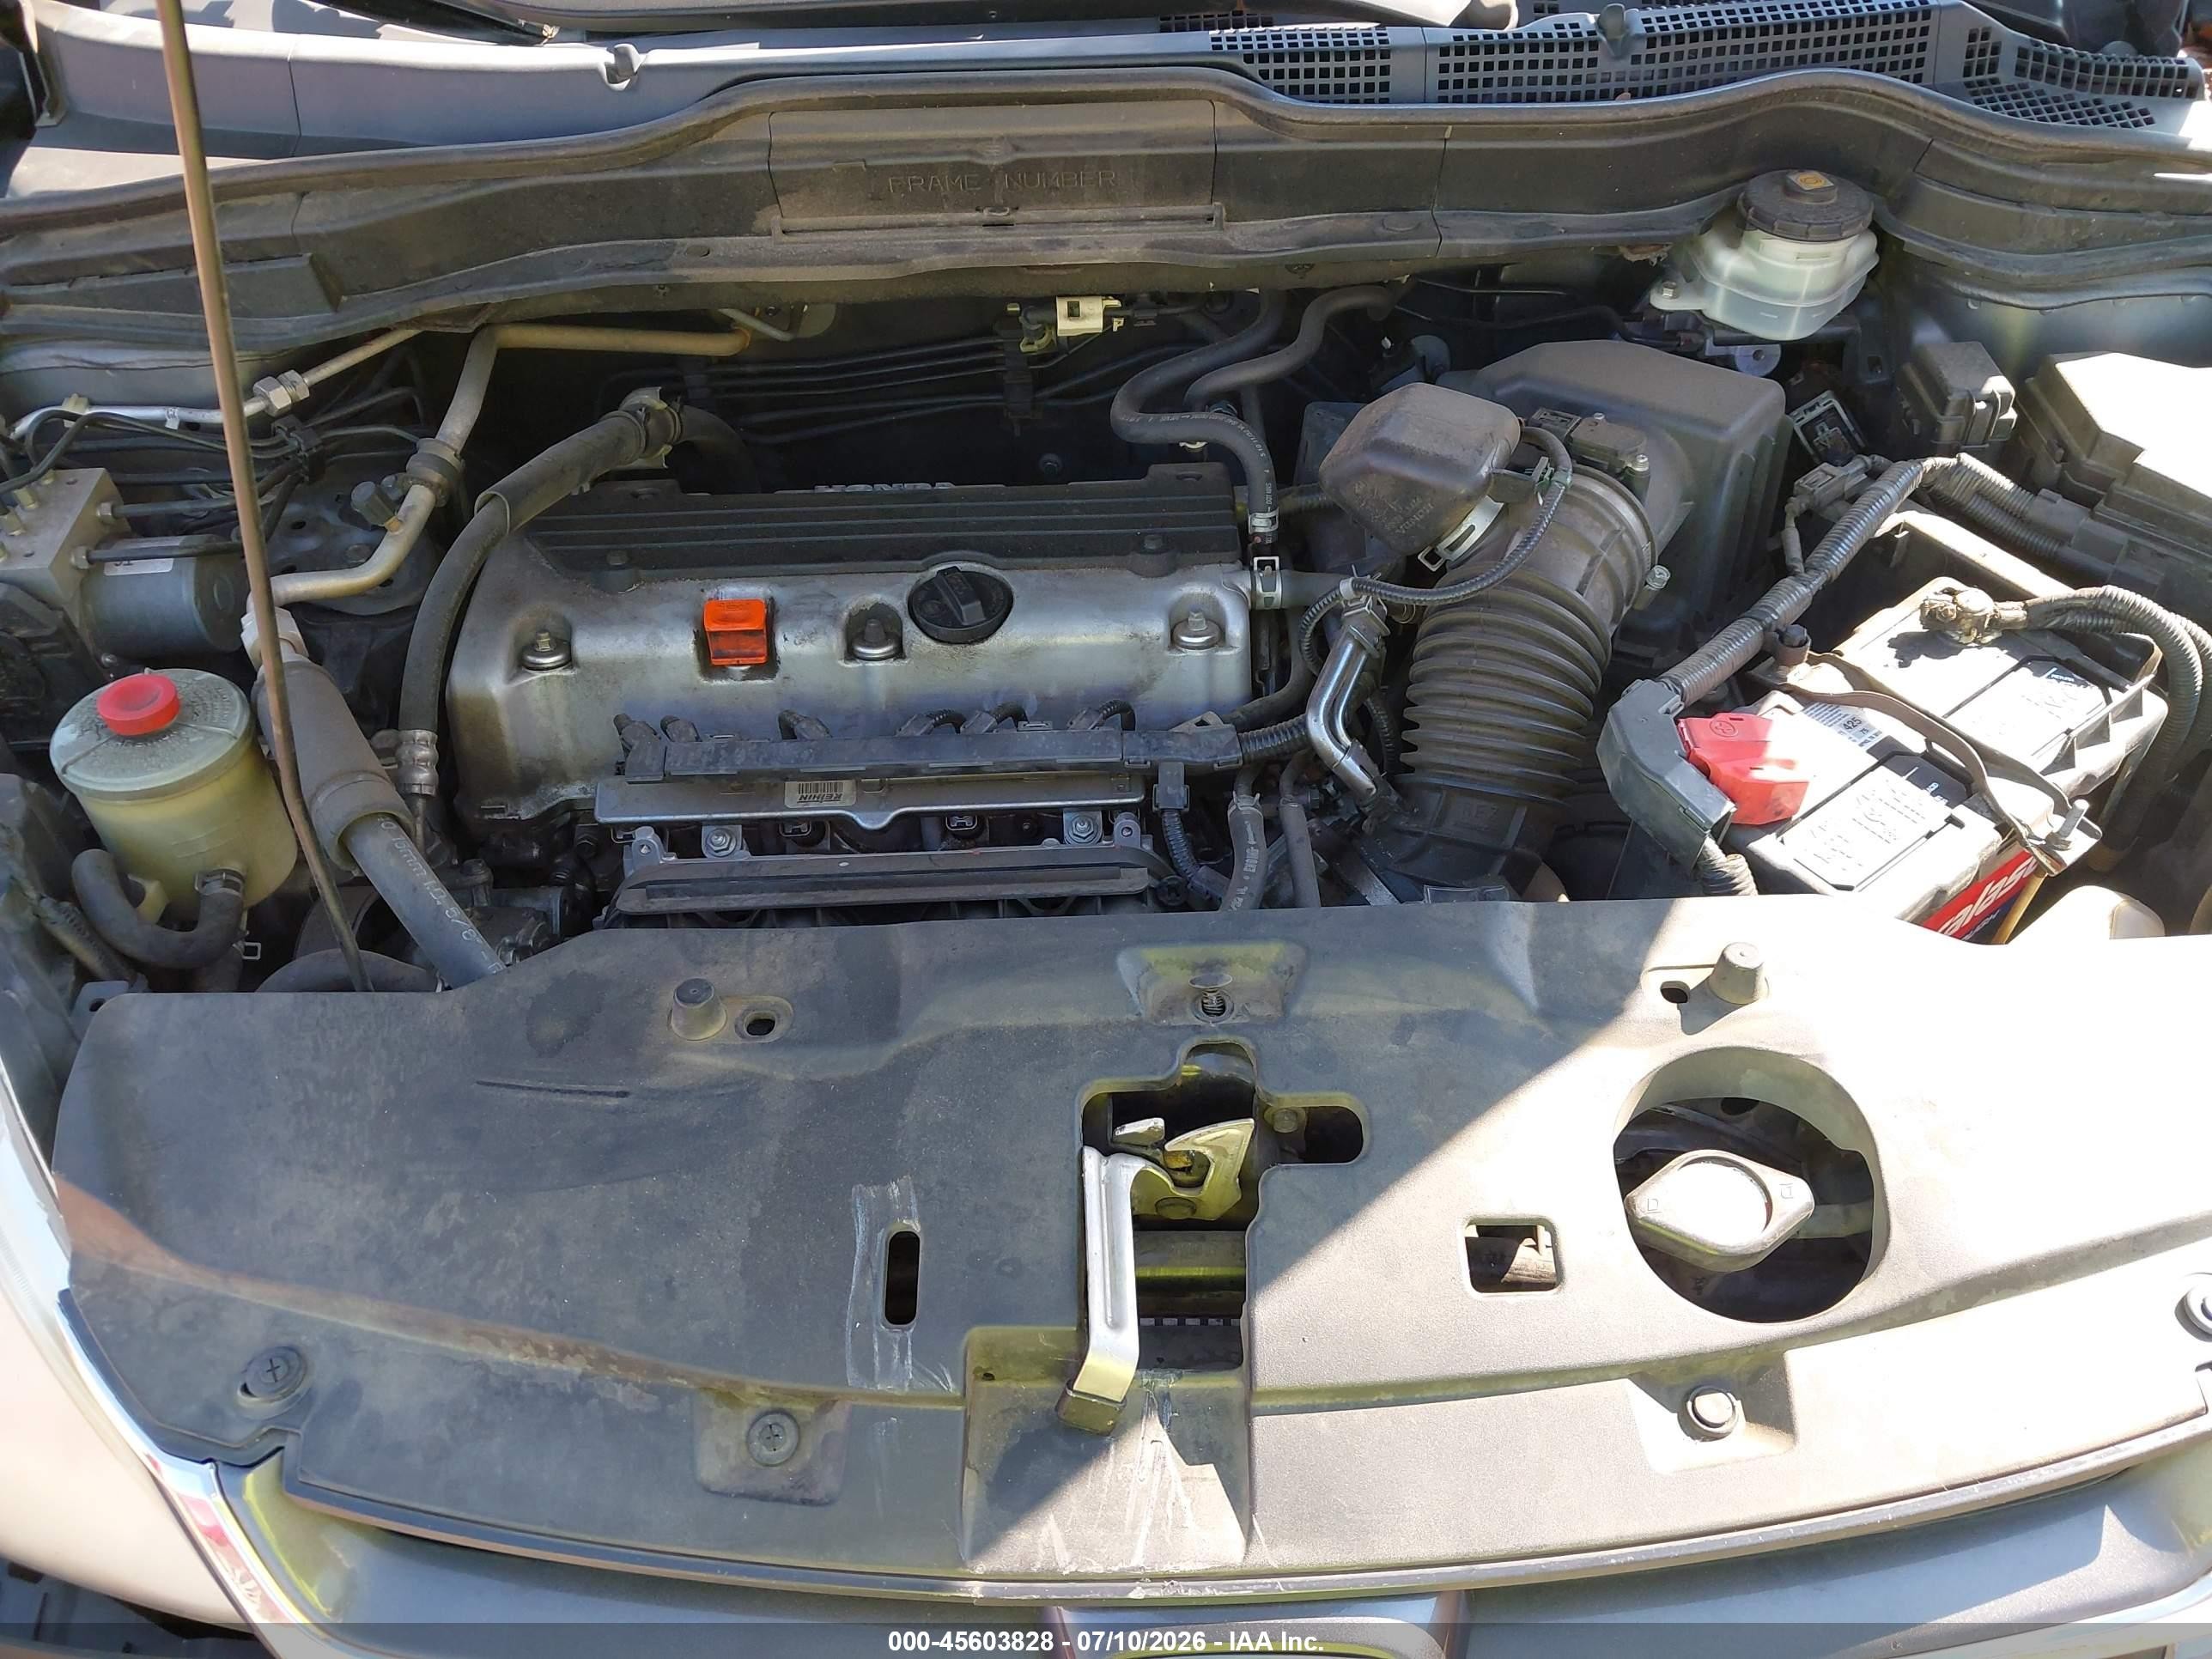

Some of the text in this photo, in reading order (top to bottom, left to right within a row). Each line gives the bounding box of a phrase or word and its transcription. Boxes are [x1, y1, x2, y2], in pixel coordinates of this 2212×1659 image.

[888, 170, 1115, 193] FRAME NUMBER
[1843, 716, 1863, 731] 425
[798, 793, 843, 804] KEIHIN
